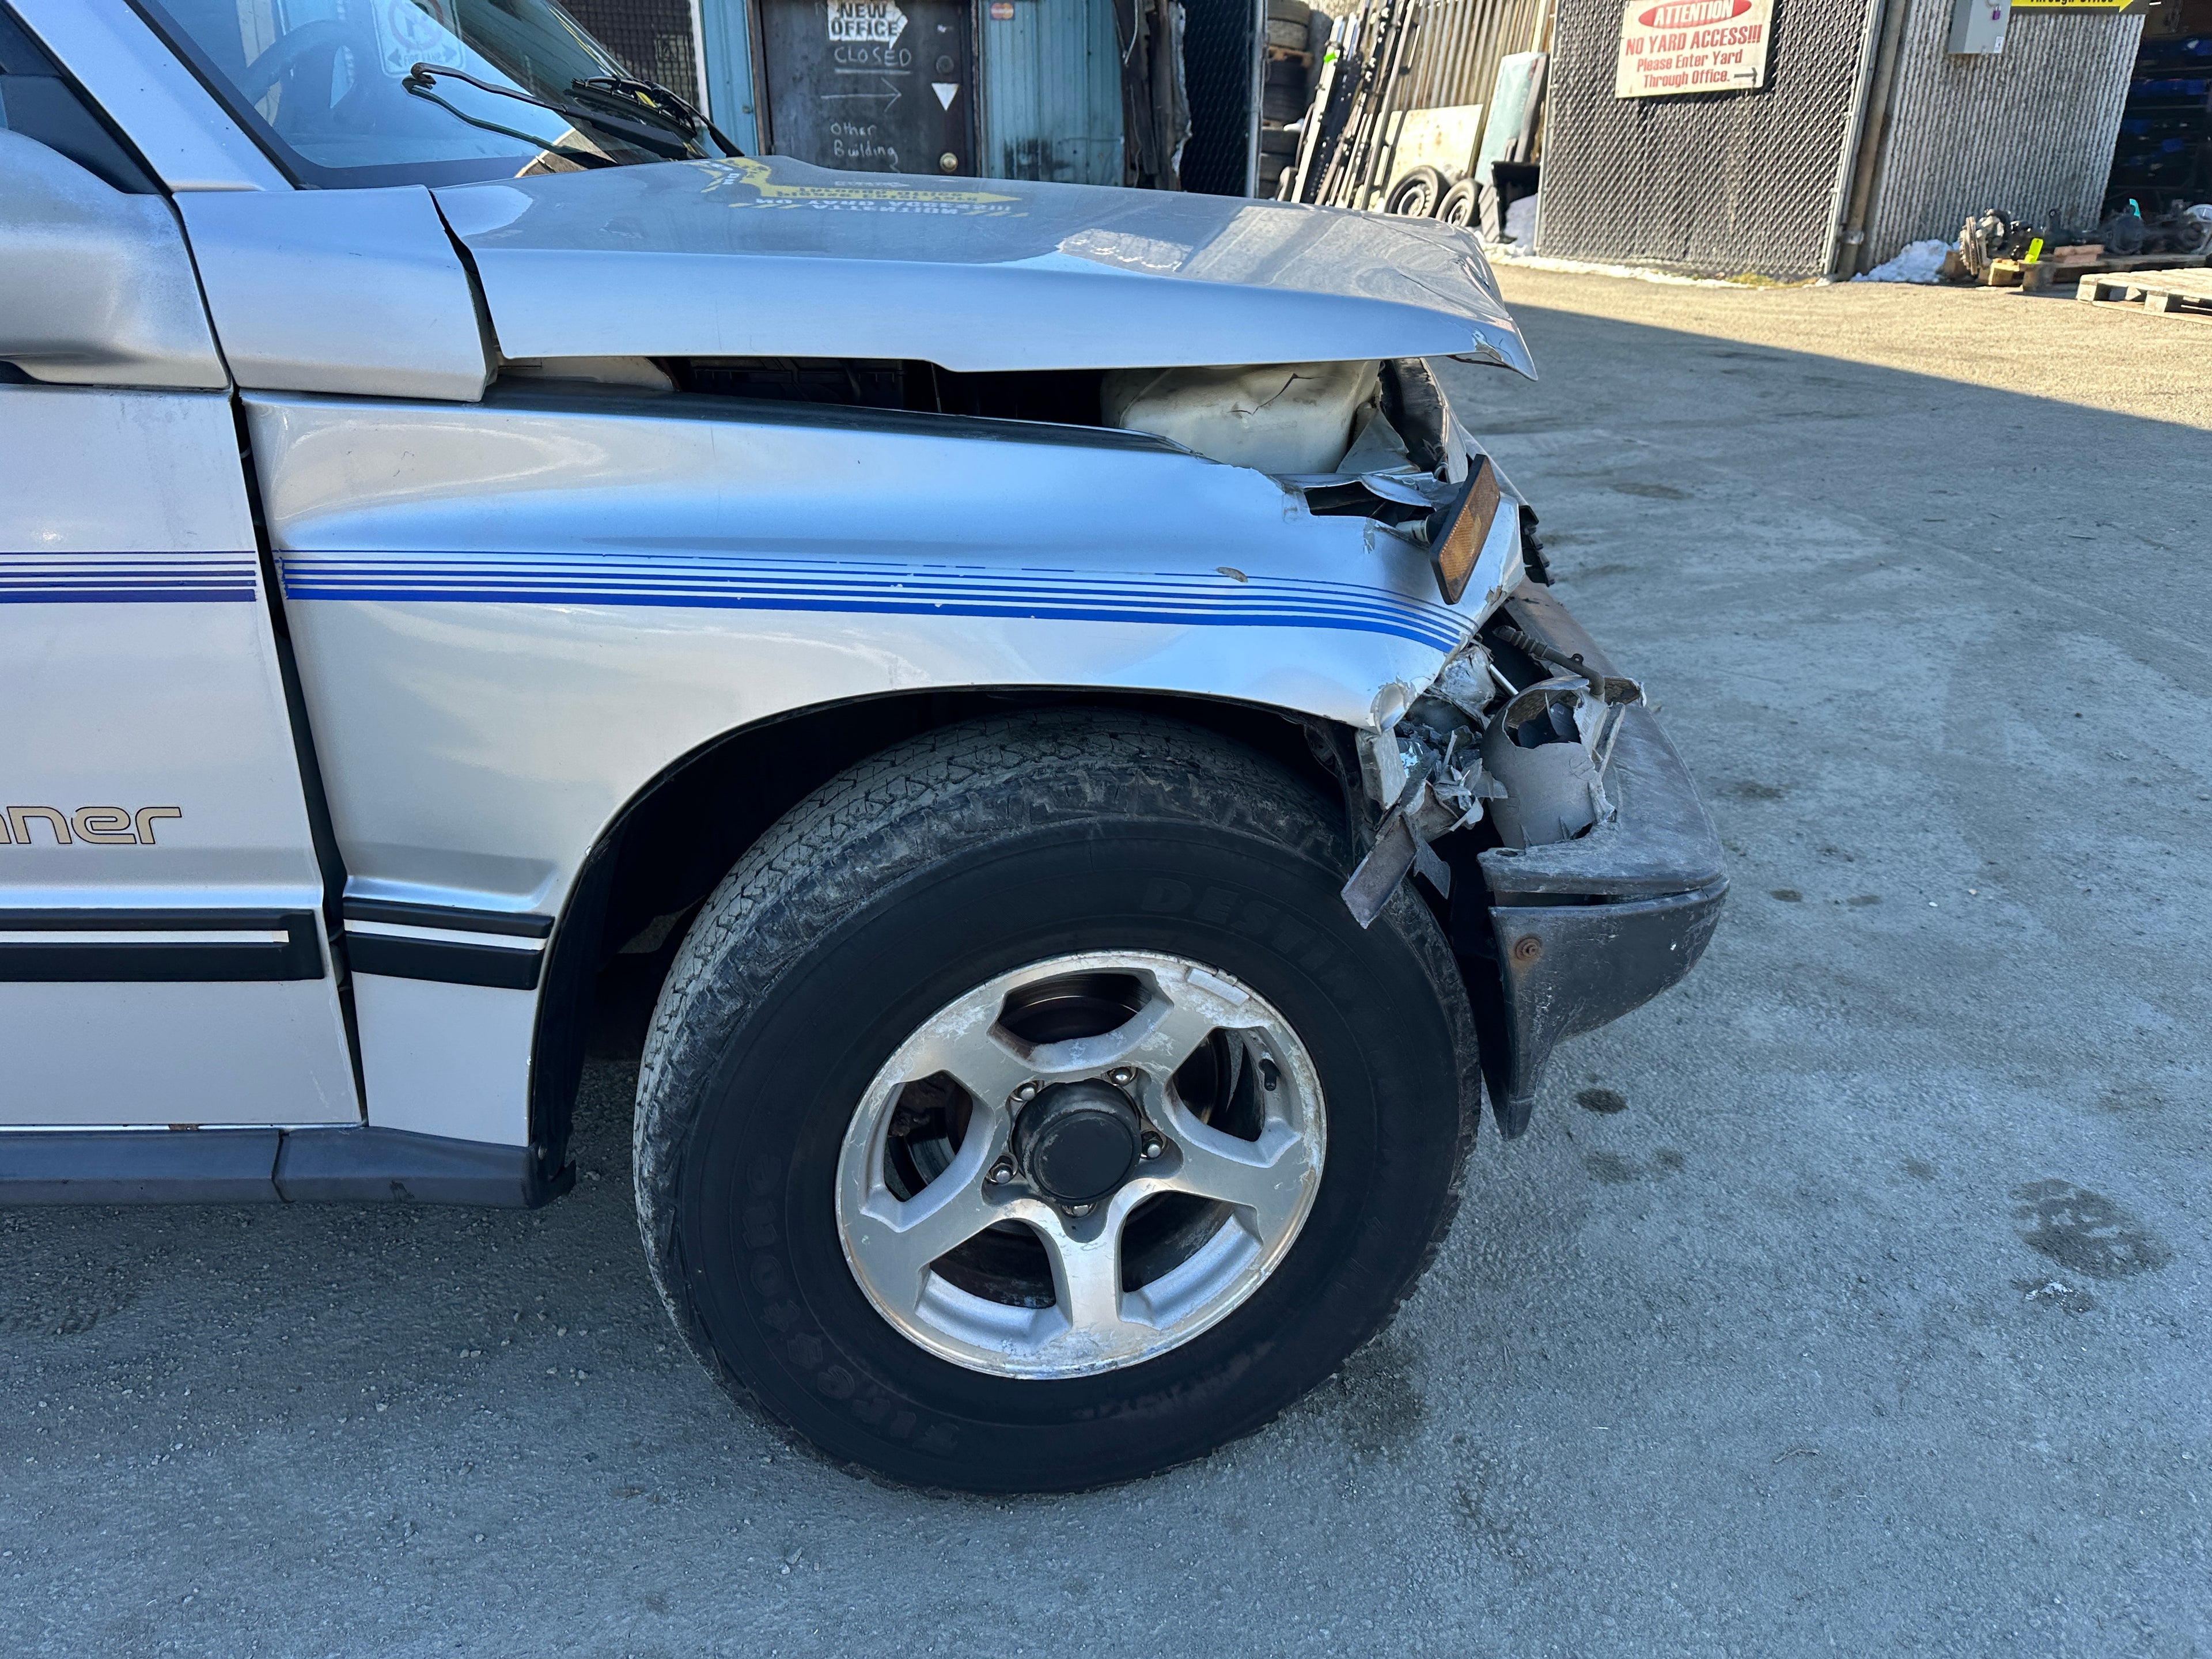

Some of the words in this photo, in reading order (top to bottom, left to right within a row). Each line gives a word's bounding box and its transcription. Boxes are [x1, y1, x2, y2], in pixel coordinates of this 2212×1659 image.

[840, 3, 886, 18] NEW
[1653, 1, 1733, 26] ATTENTION
[831, 18, 899, 36] OFFICE
[1625, 38, 1643, 56] NO
[1649, 33, 1687, 53] YARD
[1690, 25, 1763, 49] ACCESS!!!
[835, 46, 912, 67] CLOSED
[1637, 56, 1672, 73] Please
[1676, 53, 1708, 69] Enter
[1713, 49, 1743, 65] Yard
[1643, 71, 1688, 89] Through
[1691, 68, 1730, 84] Office.
[831, 123, 877, 136] Other
[834, 139, 899, 165] Building
[0, 806, 182, 844] ner
